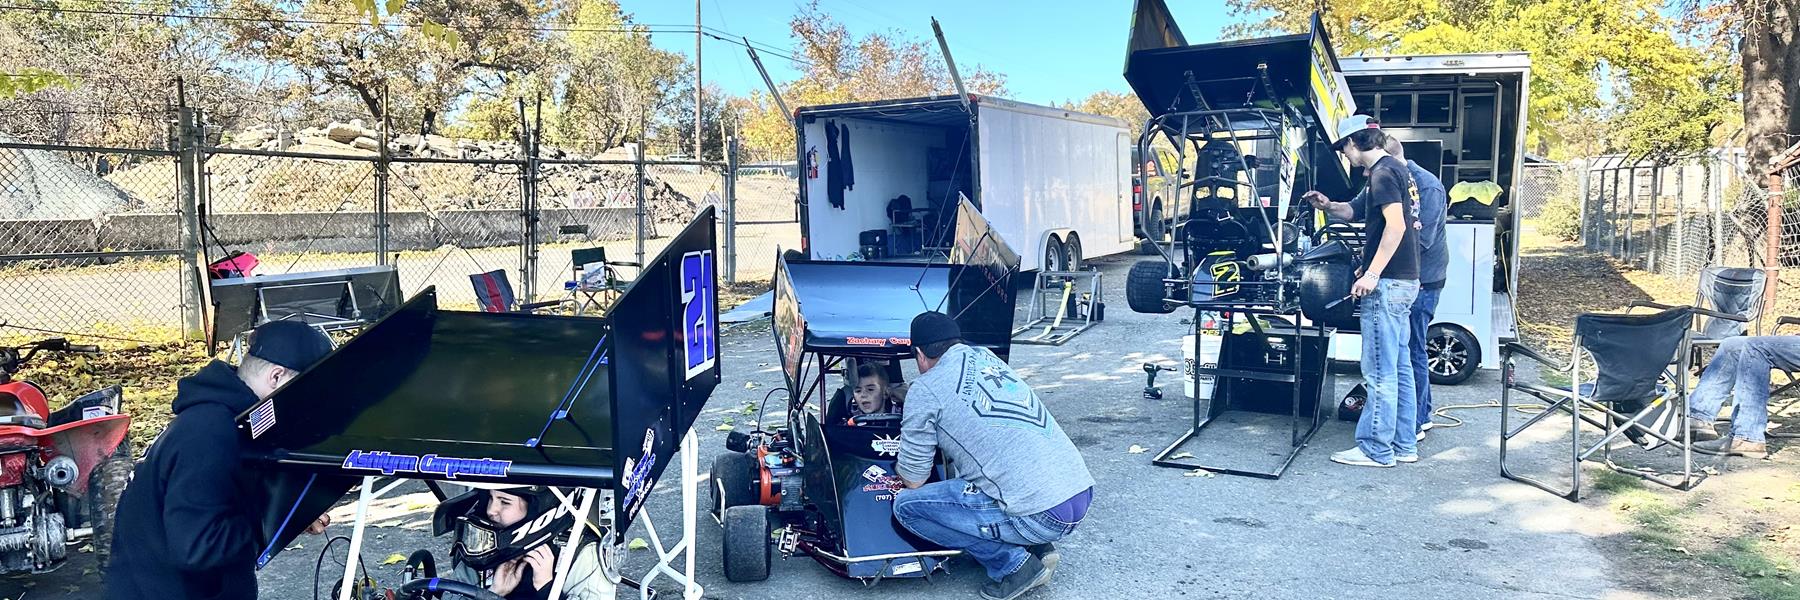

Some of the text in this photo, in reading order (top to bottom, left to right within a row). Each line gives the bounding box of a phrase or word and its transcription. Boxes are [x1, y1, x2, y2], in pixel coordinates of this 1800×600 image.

[1210, 261, 1241, 299] 2
[681, 250, 715, 380] 21
[846, 336, 887, 347] Zachary
[342, 450, 512, 479] Ashlynn Carpenter
